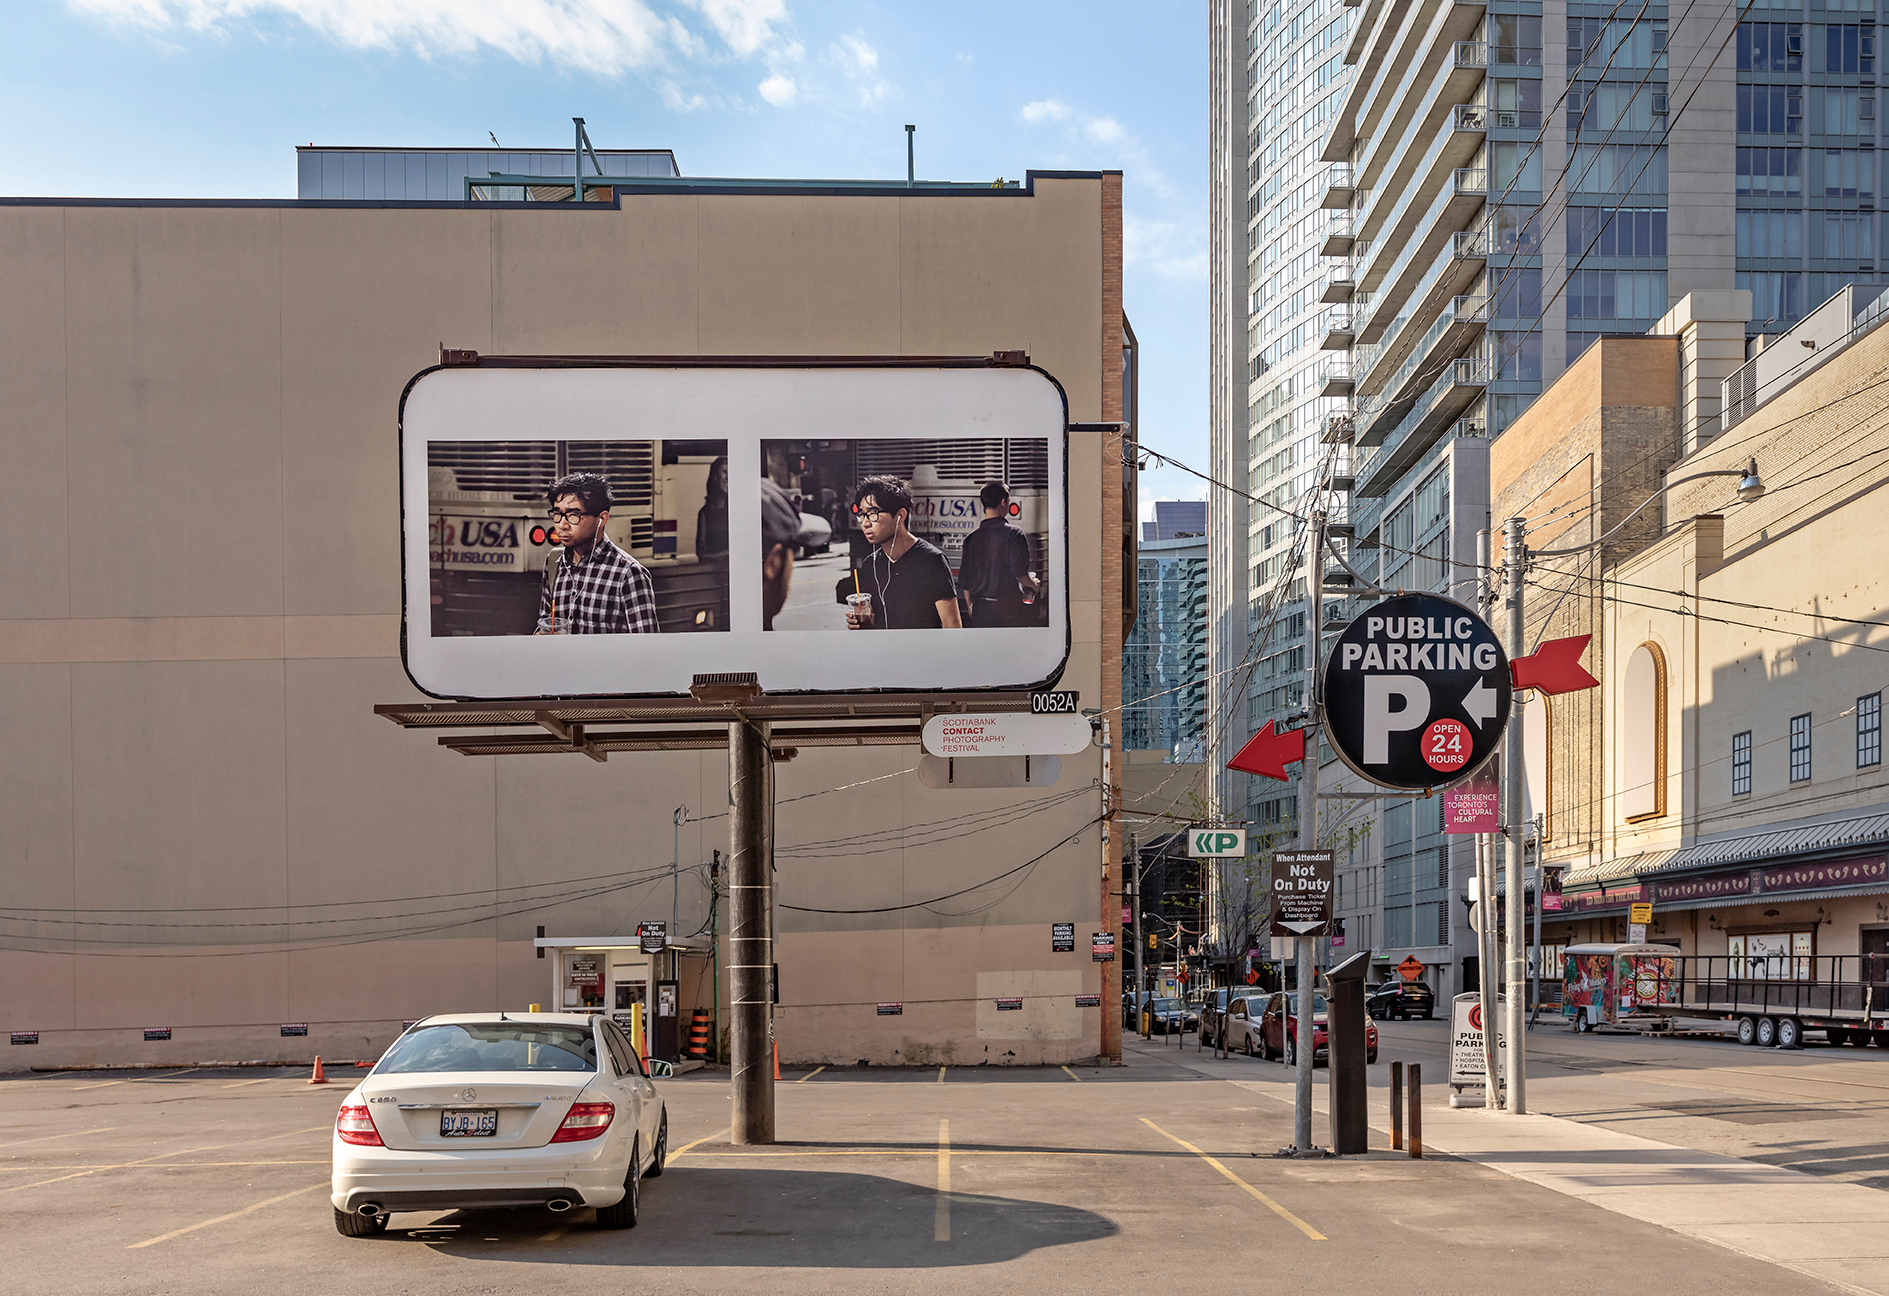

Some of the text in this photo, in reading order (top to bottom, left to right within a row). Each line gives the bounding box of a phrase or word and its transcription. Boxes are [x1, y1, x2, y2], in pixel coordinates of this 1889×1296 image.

[940, 500, 977, 517] USA
[460, 521, 519, 547] USA
[1367, 616, 1473, 640] PUBLIC
[1342, 643, 1497, 671] PARKING
[1032, 692, 1075, 712] 0052A
[942, 718, 997, 727] SCOTIABANK
[1363, 674, 1431, 765] P
[942, 727, 985, 735] CONTACT
[1433, 725, 1461, 733] OPEN
[942, 735, 1006, 744] PHOTOGRAPHY
[1431, 734, 1462, 753] 24
[942, 744, 980, 752] FESTIVAL
[1428, 755, 1464, 764] HOURS
[1454, 794, 1498, 802] EXPERIENCE
[1447, 801, 1488, 809] TORONTO'S
[1458, 808, 1493, 816] CULTURAL
[1276, 853, 1331, 862] When Attendant
[1290, 864, 1315, 876] Not
[1274, 878, 1331, 893] On Duty
[443, 1116, 495, 1130] BYJB 165
